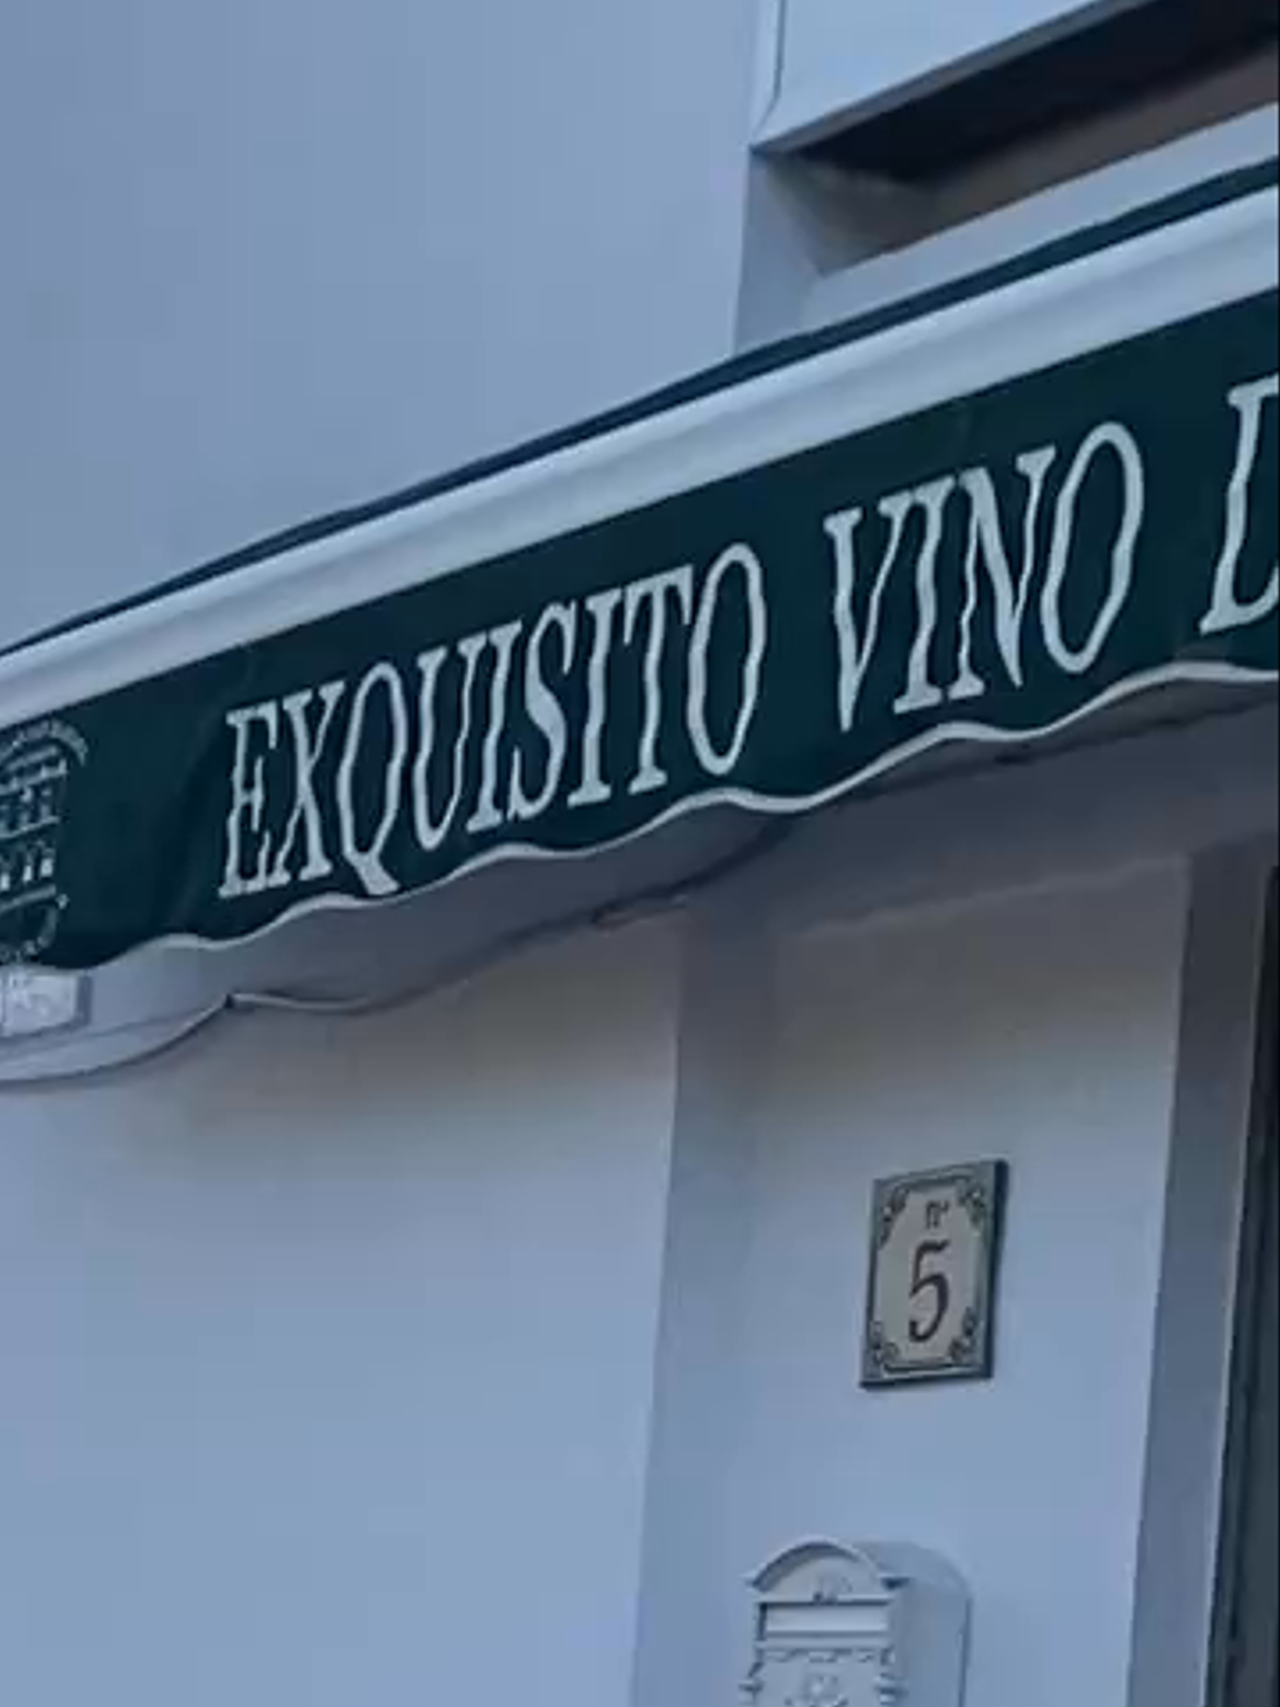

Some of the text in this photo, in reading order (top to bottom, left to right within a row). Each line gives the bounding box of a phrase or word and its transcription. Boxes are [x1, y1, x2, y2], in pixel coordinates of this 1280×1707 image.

[218, 541, 768, 896] EXQUISITO
[823, 419, 1144, 731] VINO
[908, 1238, 951, 1344] 5
